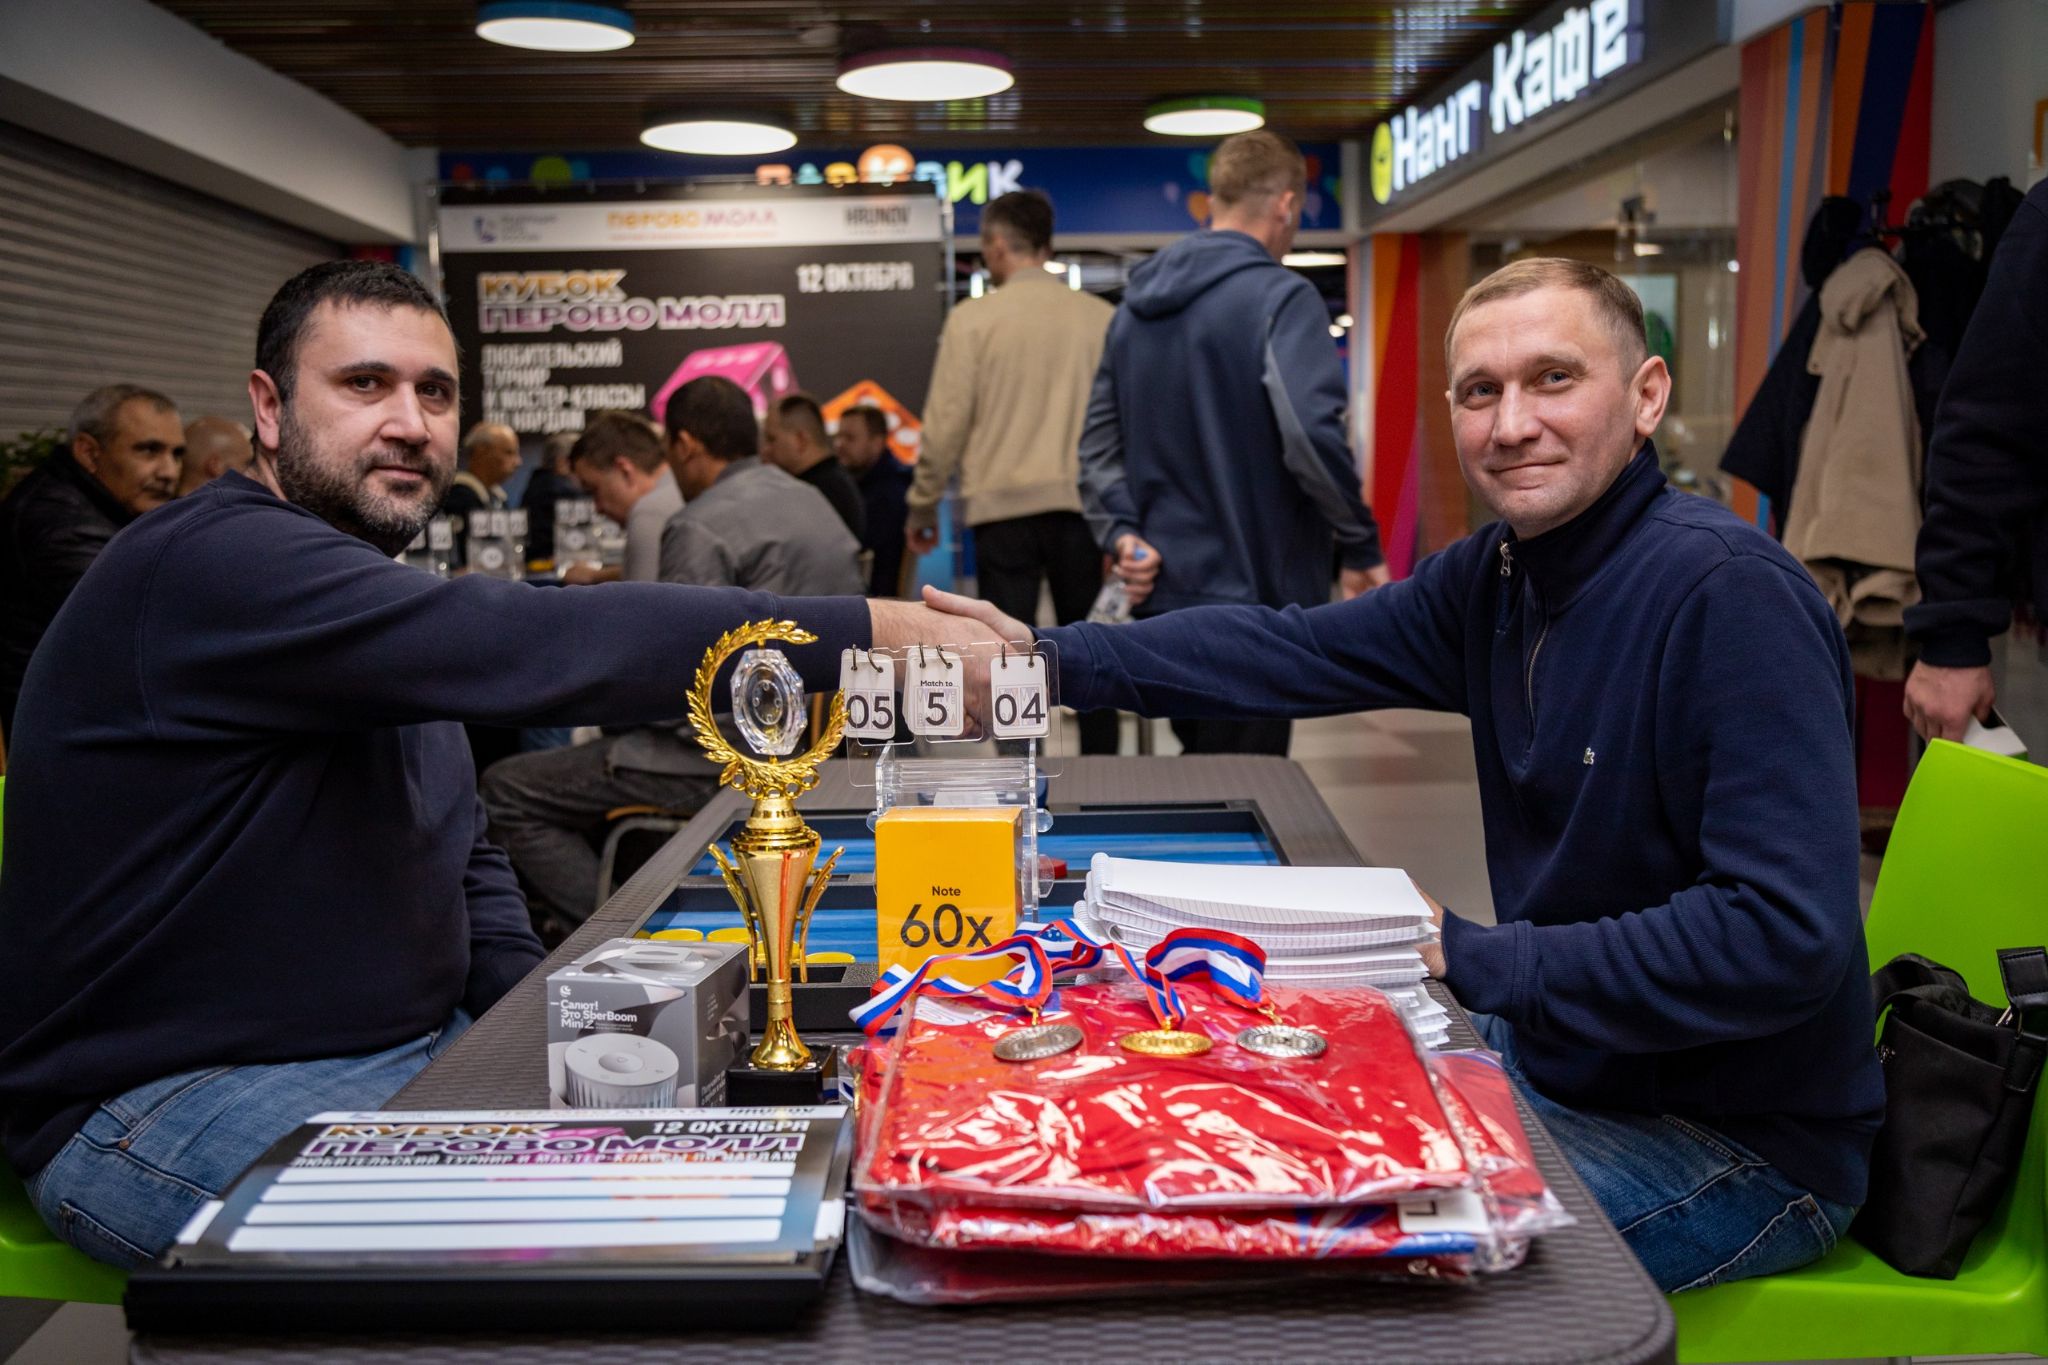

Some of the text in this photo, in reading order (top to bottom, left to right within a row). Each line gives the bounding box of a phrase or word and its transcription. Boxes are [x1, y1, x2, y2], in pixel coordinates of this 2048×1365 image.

[1390, 0, 1630, 191] Нанг Кафе
[479, 269, 627, 302] КУБОК
[797, 262, 914, 293] 12 ОКТЯБРЯ
[479, 294, 785, 333] ПЕРОВО МОЛЛ
[482, 338, 623, 368] ЛЮБИТЕЛЬСКИЙ
[498, 383, 645, 411] МАСТЕР-КЛАССЫ
[846, 694, 894, 730] 05
[925, 692, 948, 726] 5
[995, 692, 1046, 726] 04
[932, 886, 961, 897] Note
[900, 903, 994, 948] 60x
[561, 1000, 599, 1011] Салют!
[561, 1009, 638, 1022] Это SberBoom
[561, 1018, 584, 1029] Mini
[584, 1019, 595, 1030] 2
[319, 1123, 560, 1139] КУБОК
[653, 1120, 810, 1134] 12 ОКТЯБРЯ
[301, 1133, 806, 1157] ПЕРОВО МОЛЛ
[291, 1153, 440, 1168] ЛЮБИТЕЛЬСКИЙ
